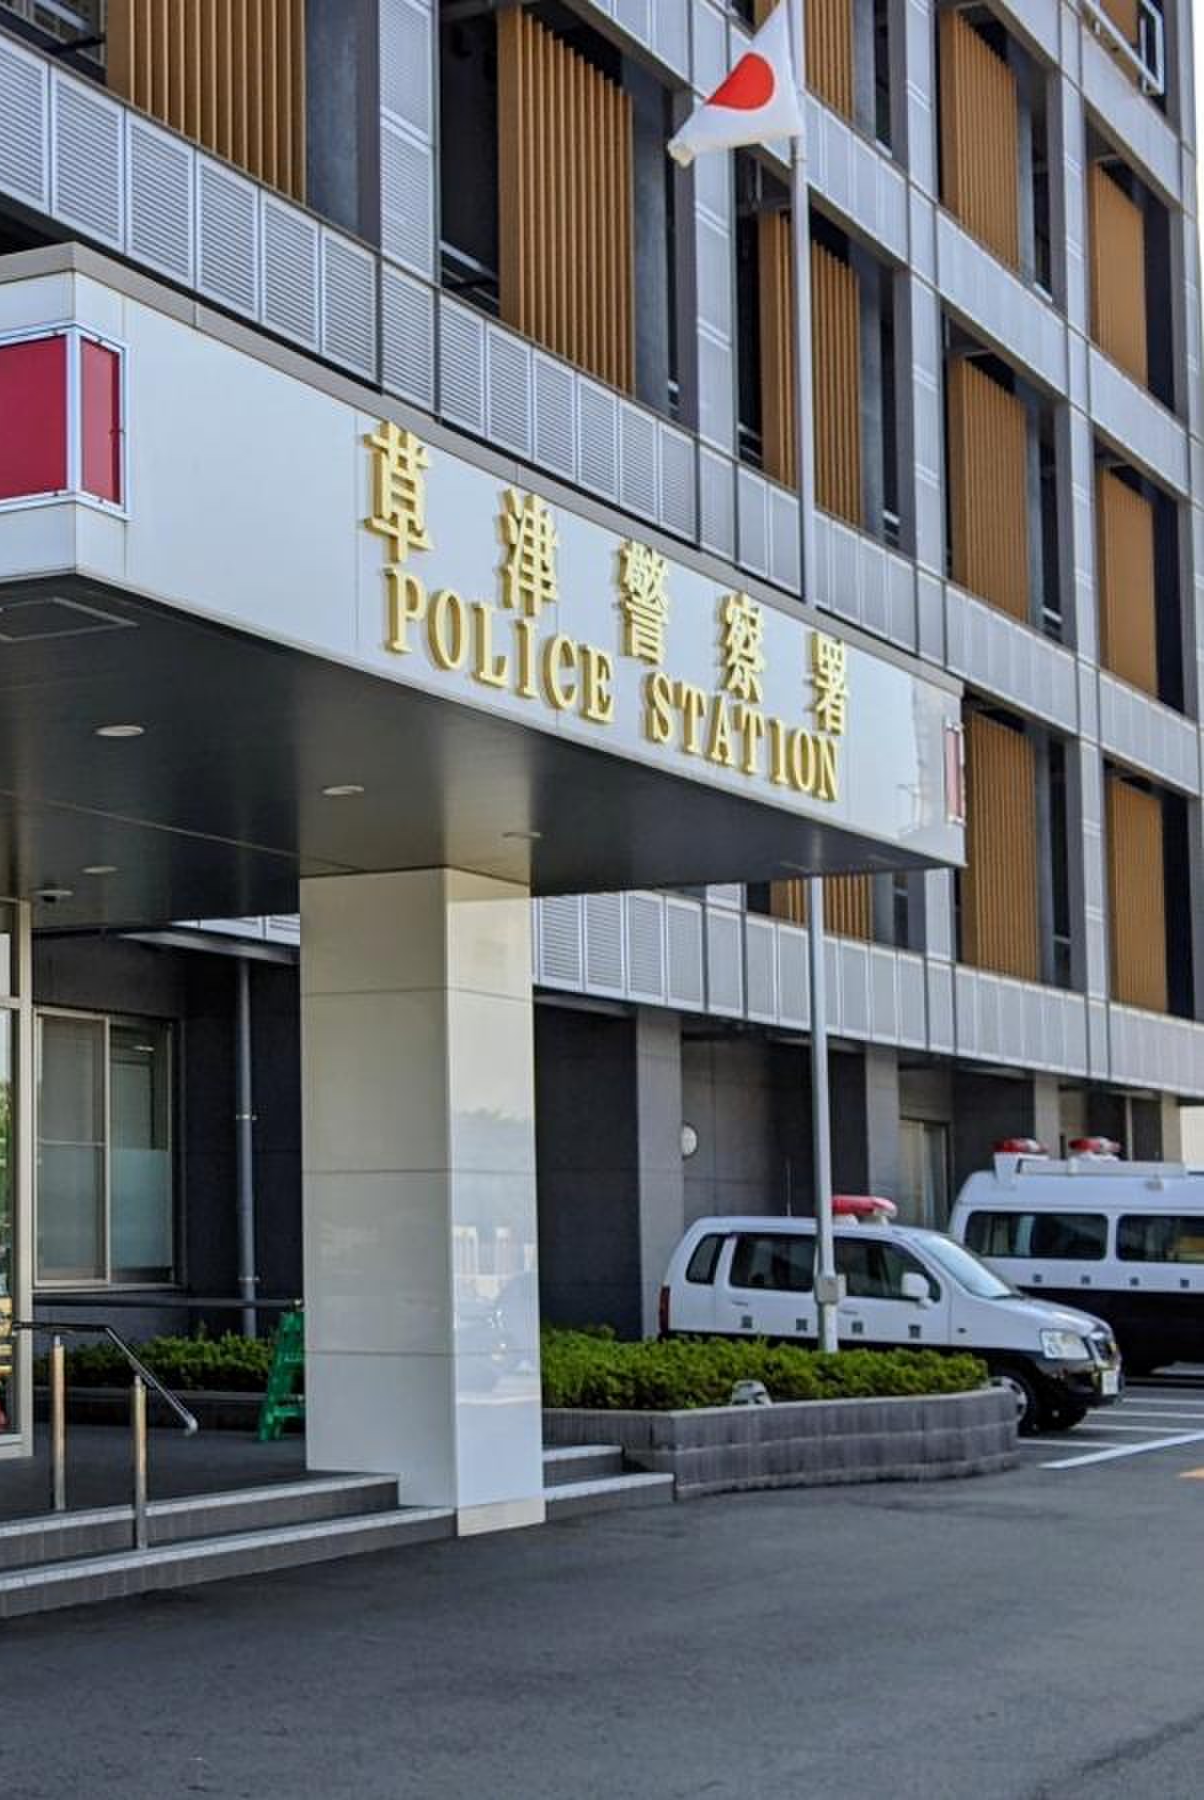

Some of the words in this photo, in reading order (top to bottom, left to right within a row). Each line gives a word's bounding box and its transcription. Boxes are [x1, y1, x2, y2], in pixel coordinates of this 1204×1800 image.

[364, 420, 849, 736] 草津警察署
[383, 566, 615, 724] POLICE
[642, 672, 839, 801] STATION
